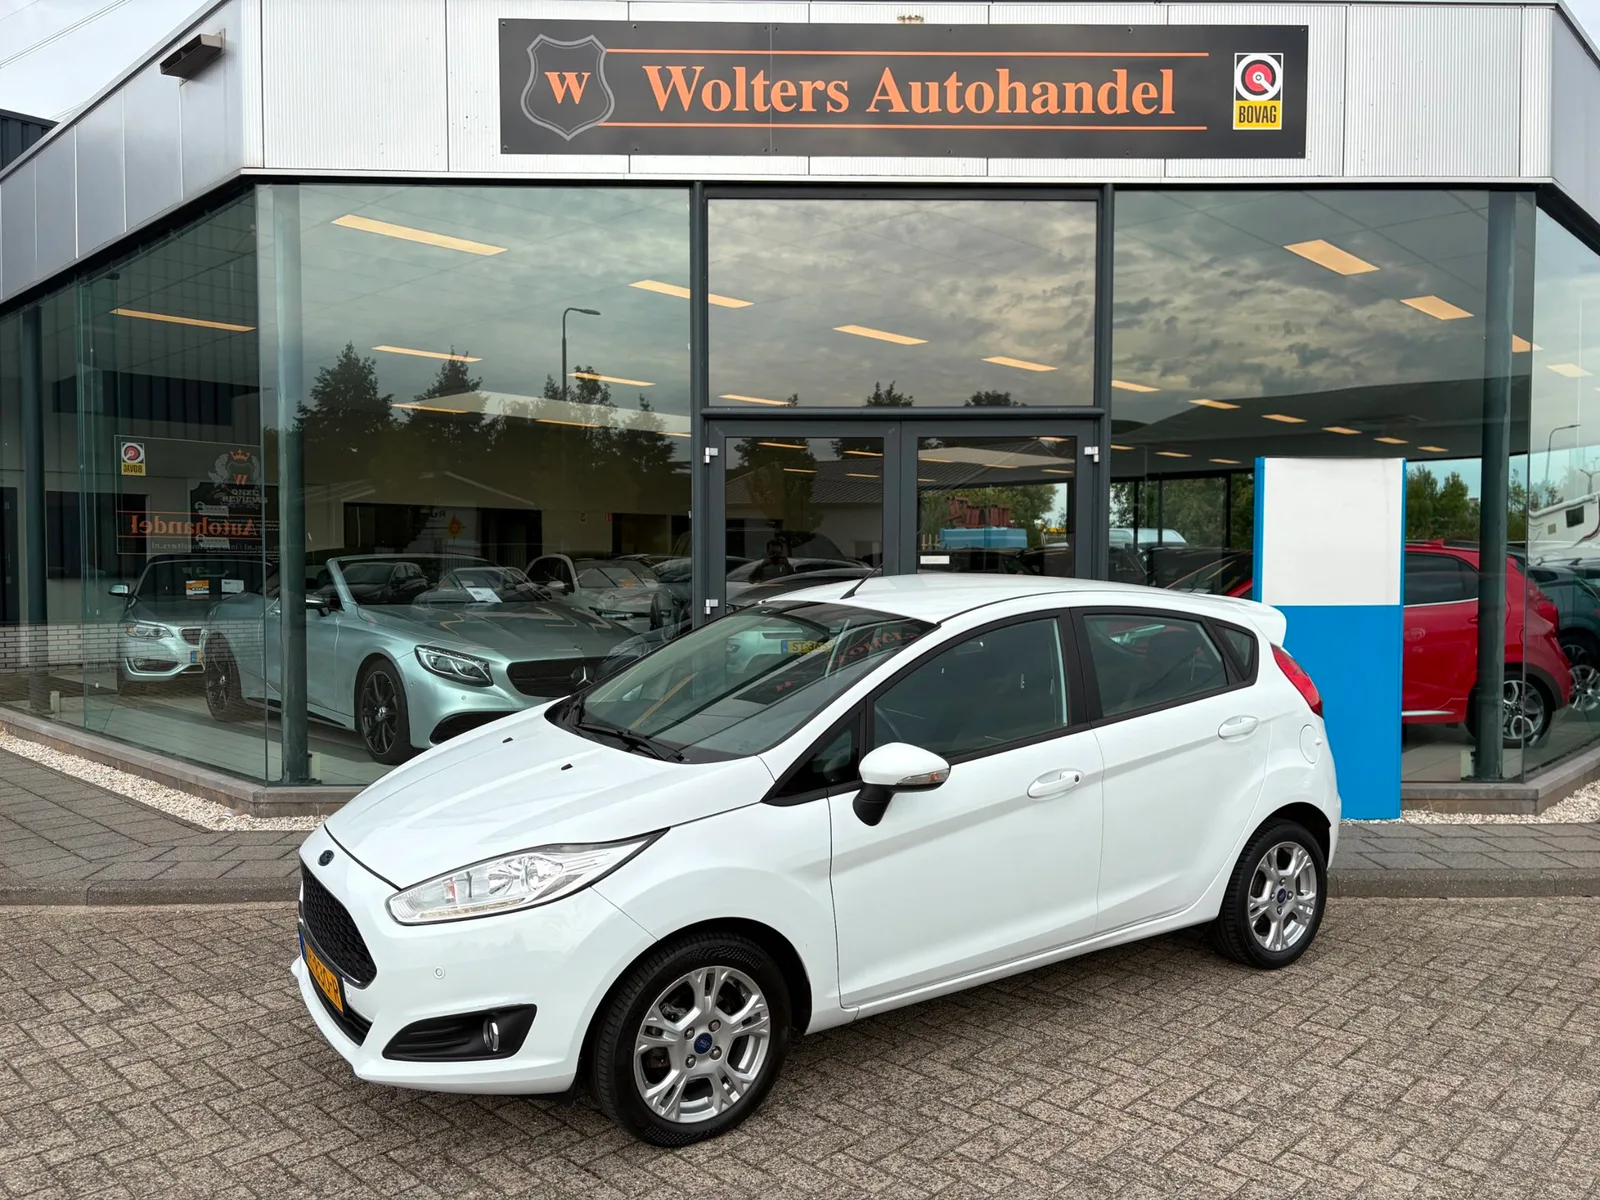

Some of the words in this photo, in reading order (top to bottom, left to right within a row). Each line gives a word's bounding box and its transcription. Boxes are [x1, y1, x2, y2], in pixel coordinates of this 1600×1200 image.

[544, 71, 592, 105] W
[642, 65, 850, 113] Wolters
[865, 66, 1176, 115] Autohandel
[1238, 105, 1278, 124] BOVAG
